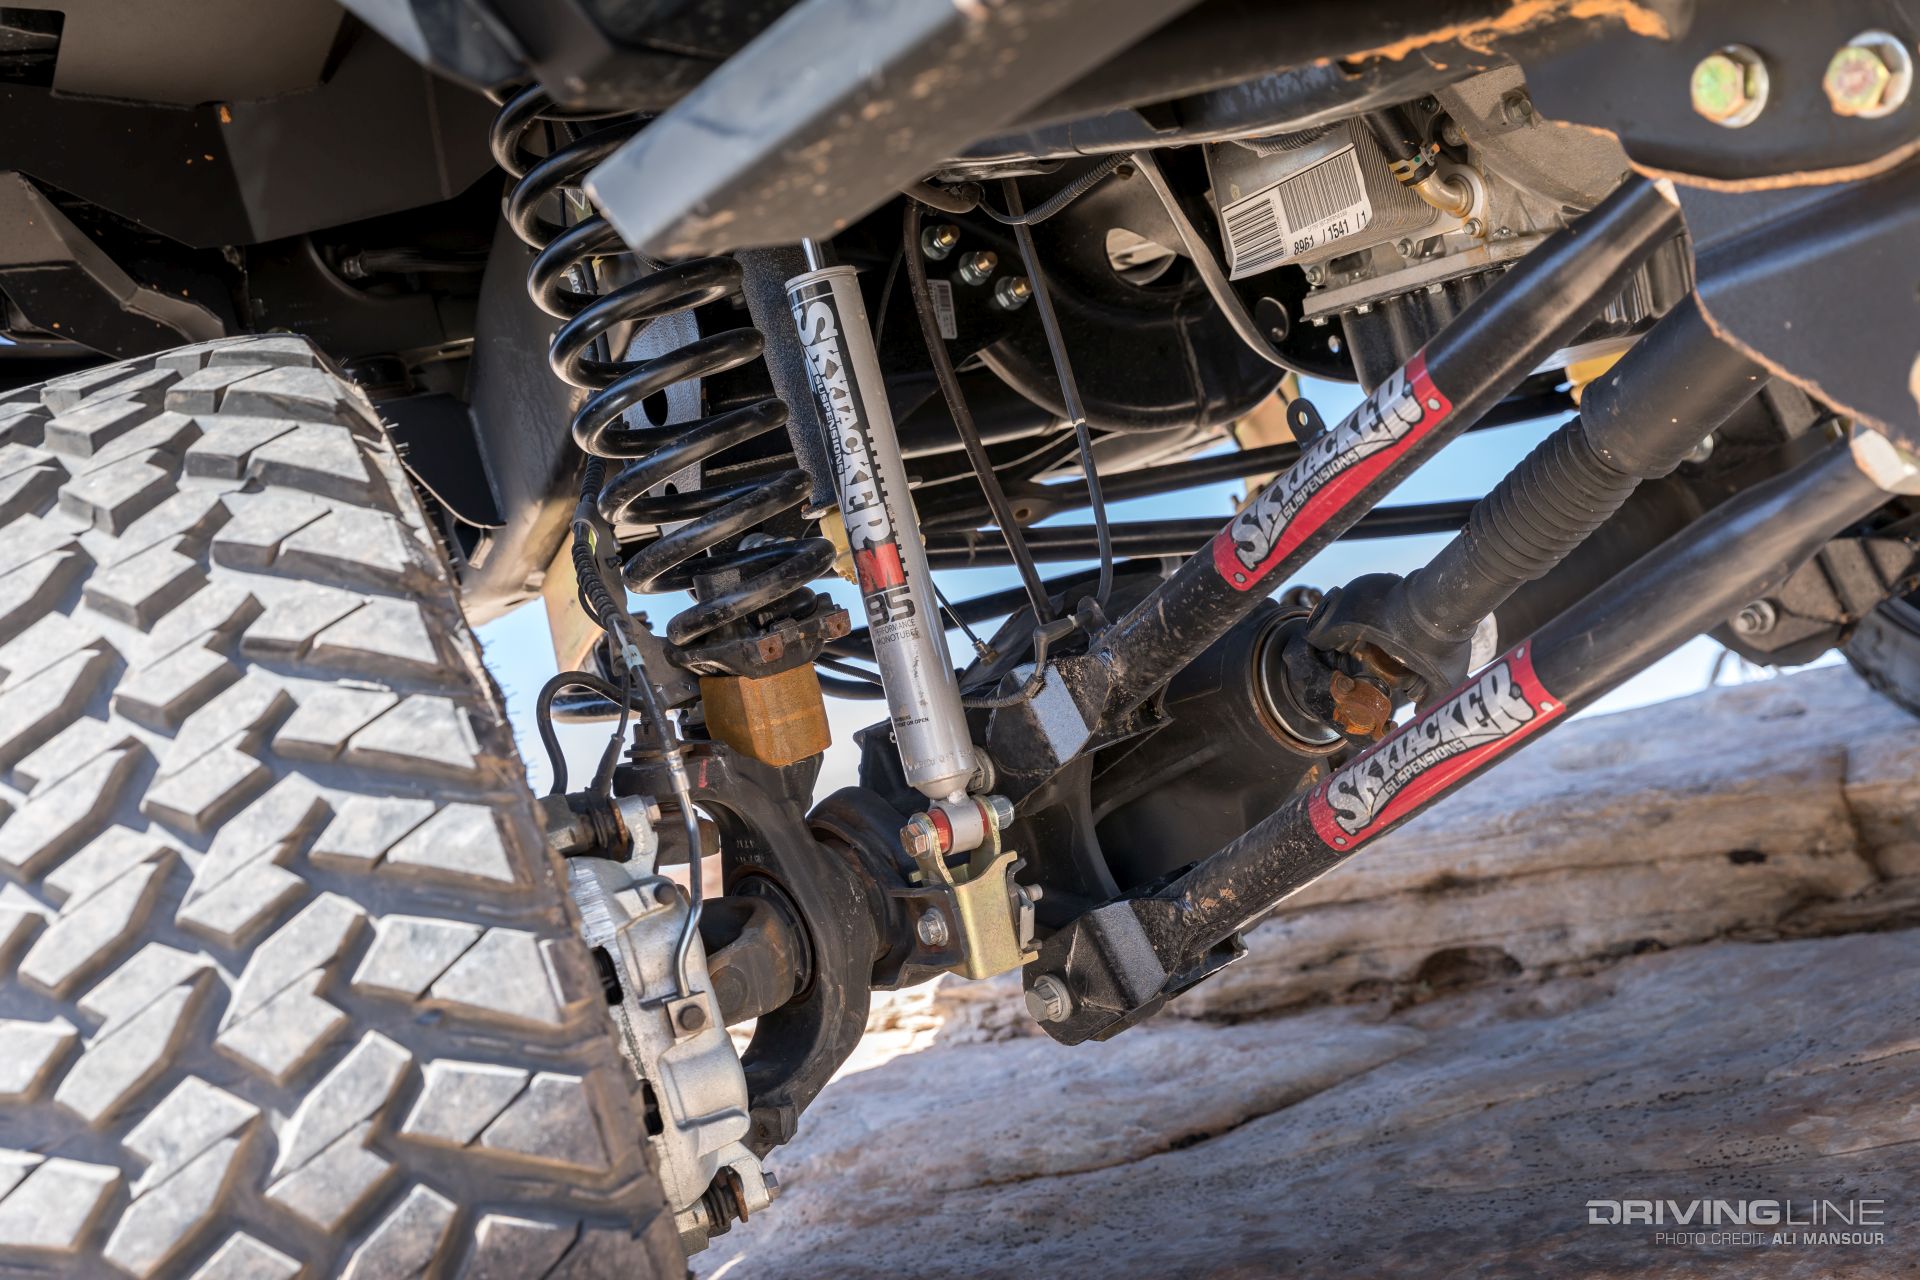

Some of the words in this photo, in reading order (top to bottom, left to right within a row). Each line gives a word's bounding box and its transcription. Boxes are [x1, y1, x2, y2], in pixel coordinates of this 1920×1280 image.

[1294, 235, 1314, 255] 8961
[1328, 219, 1349, 240] 1541
[794, 301, 890, 551] SKYJACKER
[813, 374, 845, 475] SUSPENSIONS
[1231, 367, 1423, 570] SKYJACKER
[1284, 449, 1359, 520] SUSPENSIONS
[1327, 662, 1535, 835] SKYJACKER
[1387, 739, 1466, 796] SUSPENSIONS
